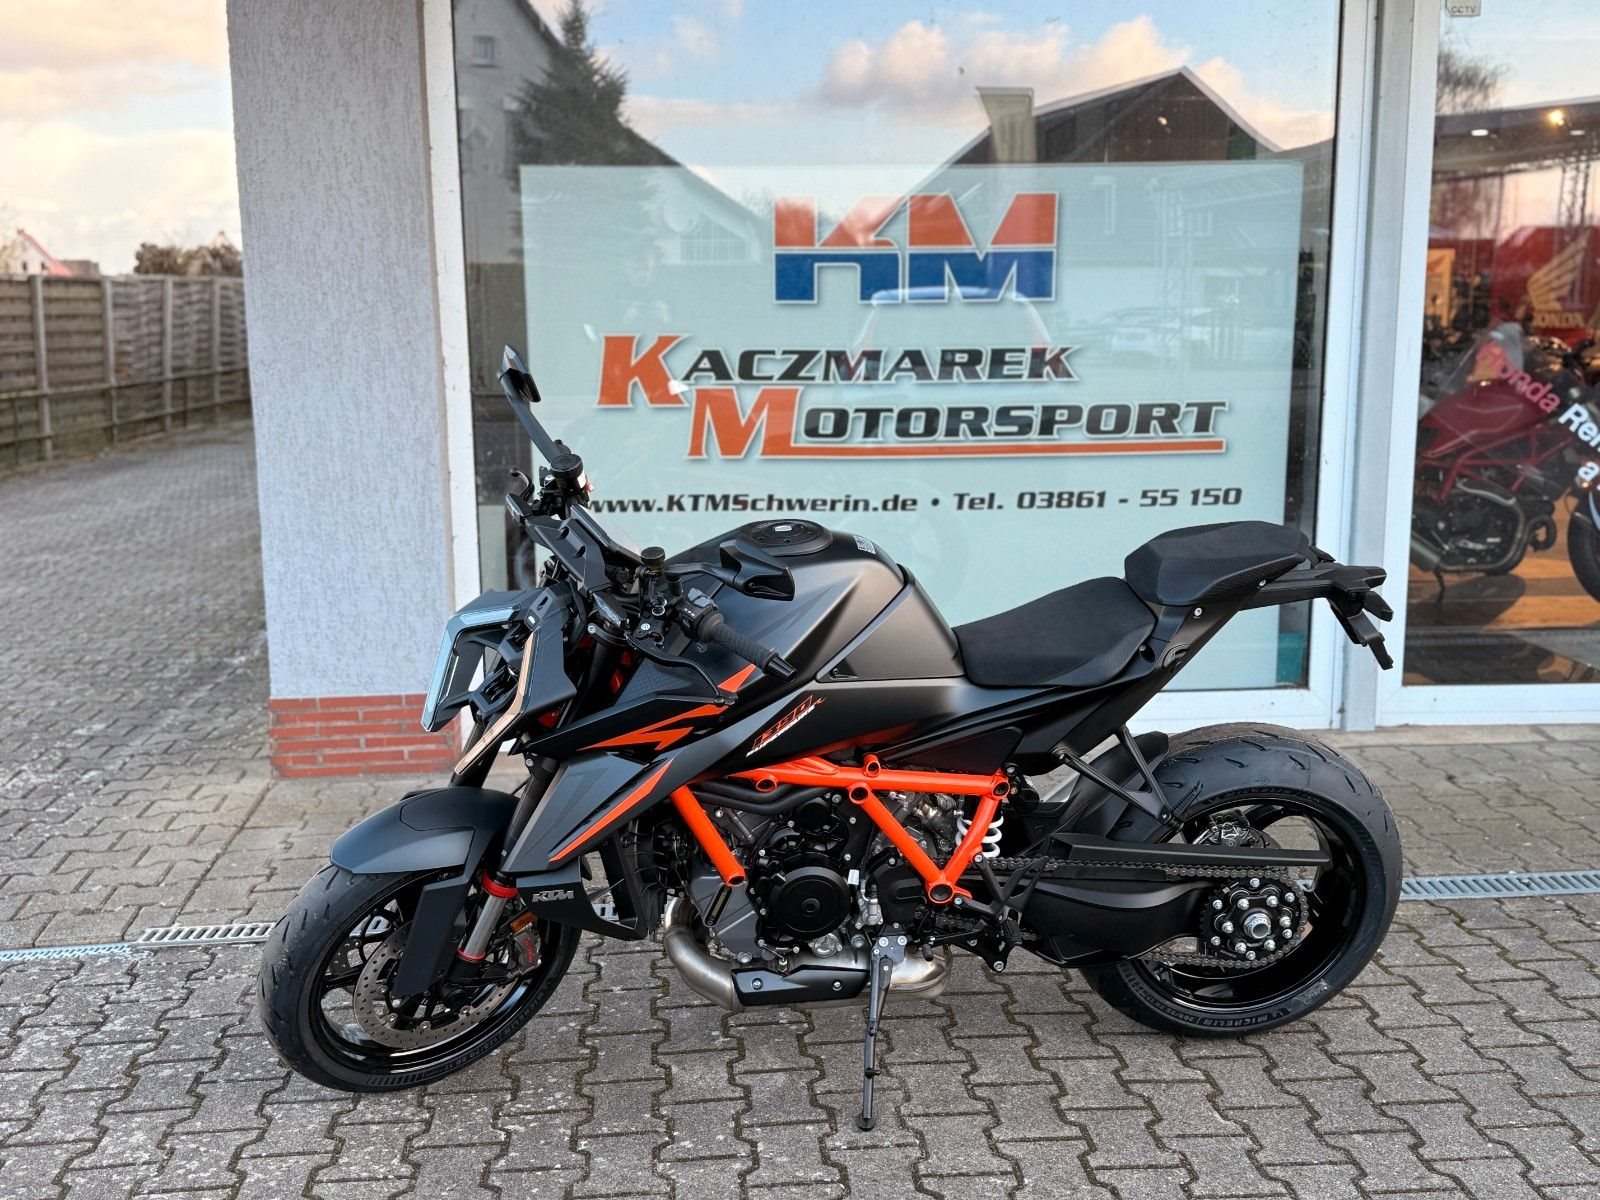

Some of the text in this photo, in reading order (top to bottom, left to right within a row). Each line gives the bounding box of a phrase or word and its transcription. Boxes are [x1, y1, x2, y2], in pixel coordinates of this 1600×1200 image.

[1451, 6, 1477, 14] CCTV
[773, 191, 1059, 305] KM
[597, 335, 1076, 407] KACZMAREK
[688, 387, 1228, 458] MOTORSPORT
[588, 494, 918, 513] www.KTMSchwerin.de
[955, 492, 1004, 511] Tel.
[1016, 490, 1107, 510] 03861
[1139, 489, 1180, 507] 55
[1190, 487, 1243, 506] 150
[532, 889, 575, 903] KTM
